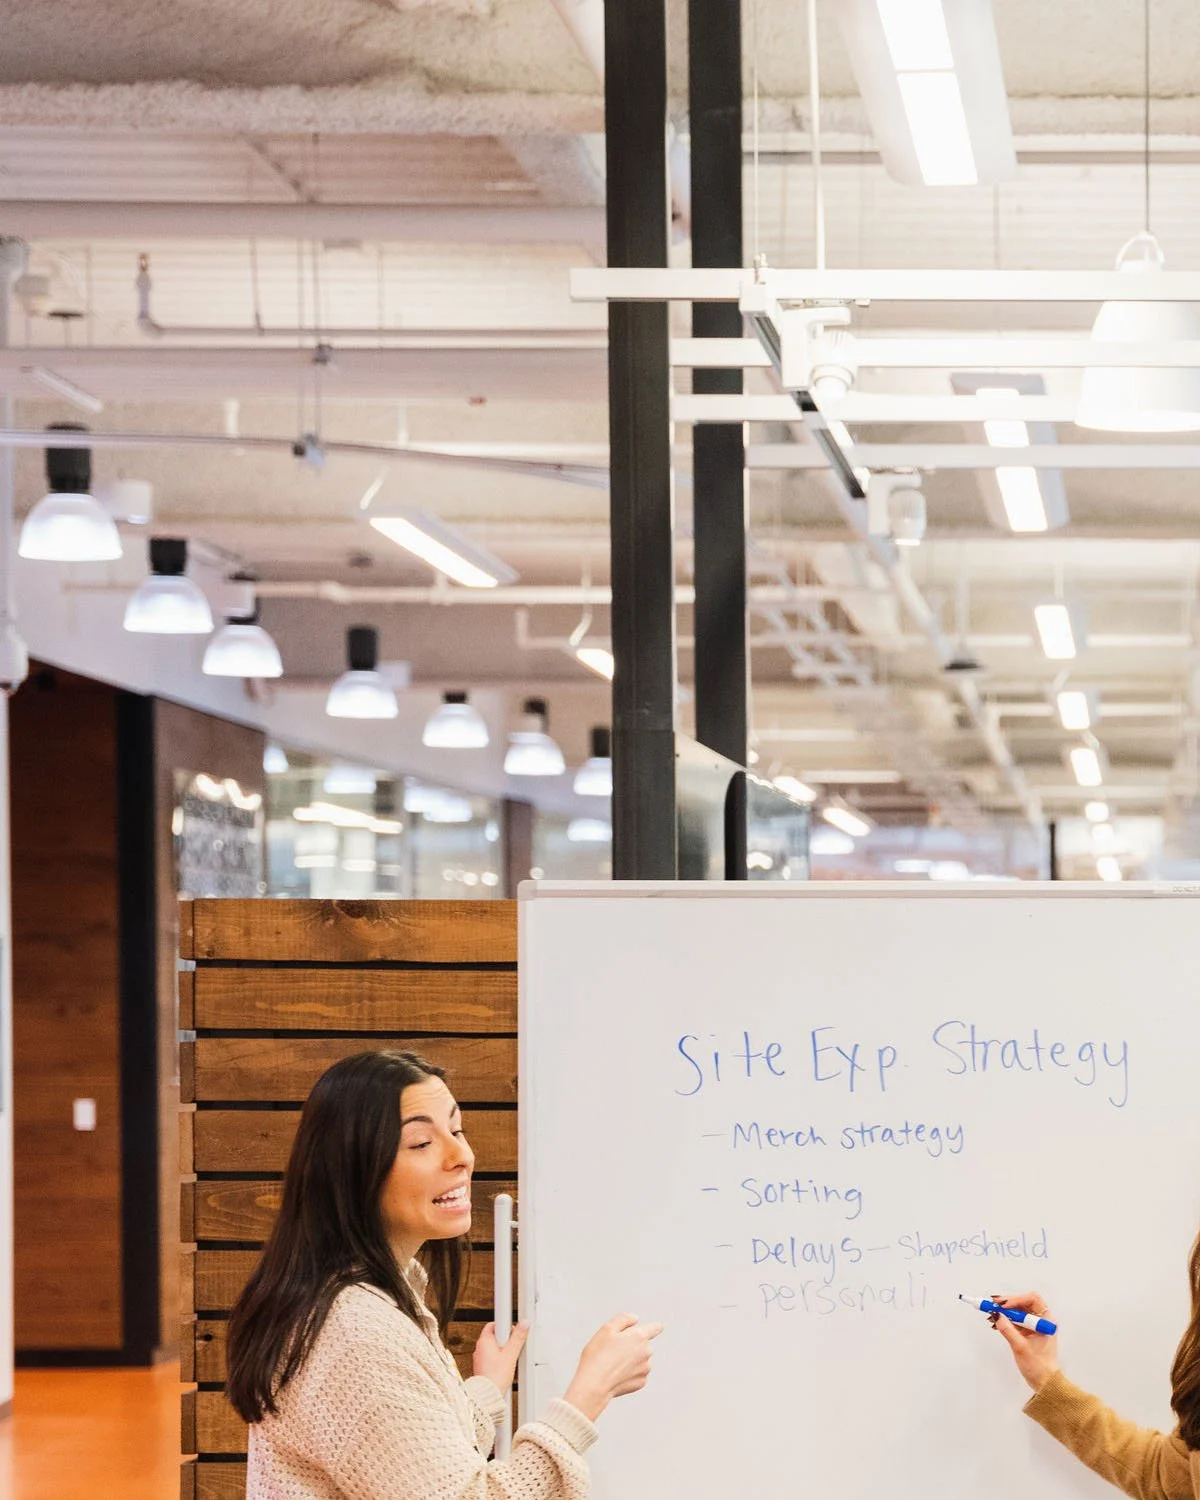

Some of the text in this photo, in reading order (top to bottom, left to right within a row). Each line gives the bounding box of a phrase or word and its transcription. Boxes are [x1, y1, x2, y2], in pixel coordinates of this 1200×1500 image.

[673, 1031, 787, 1097] Site
[932, 1020, 1130, 1108] Strategy
[732, 1121, 828, 1151] Merch
[840, 1119, 966, 1159] strategy
[740, 1178, 864, 1221] Sorting
